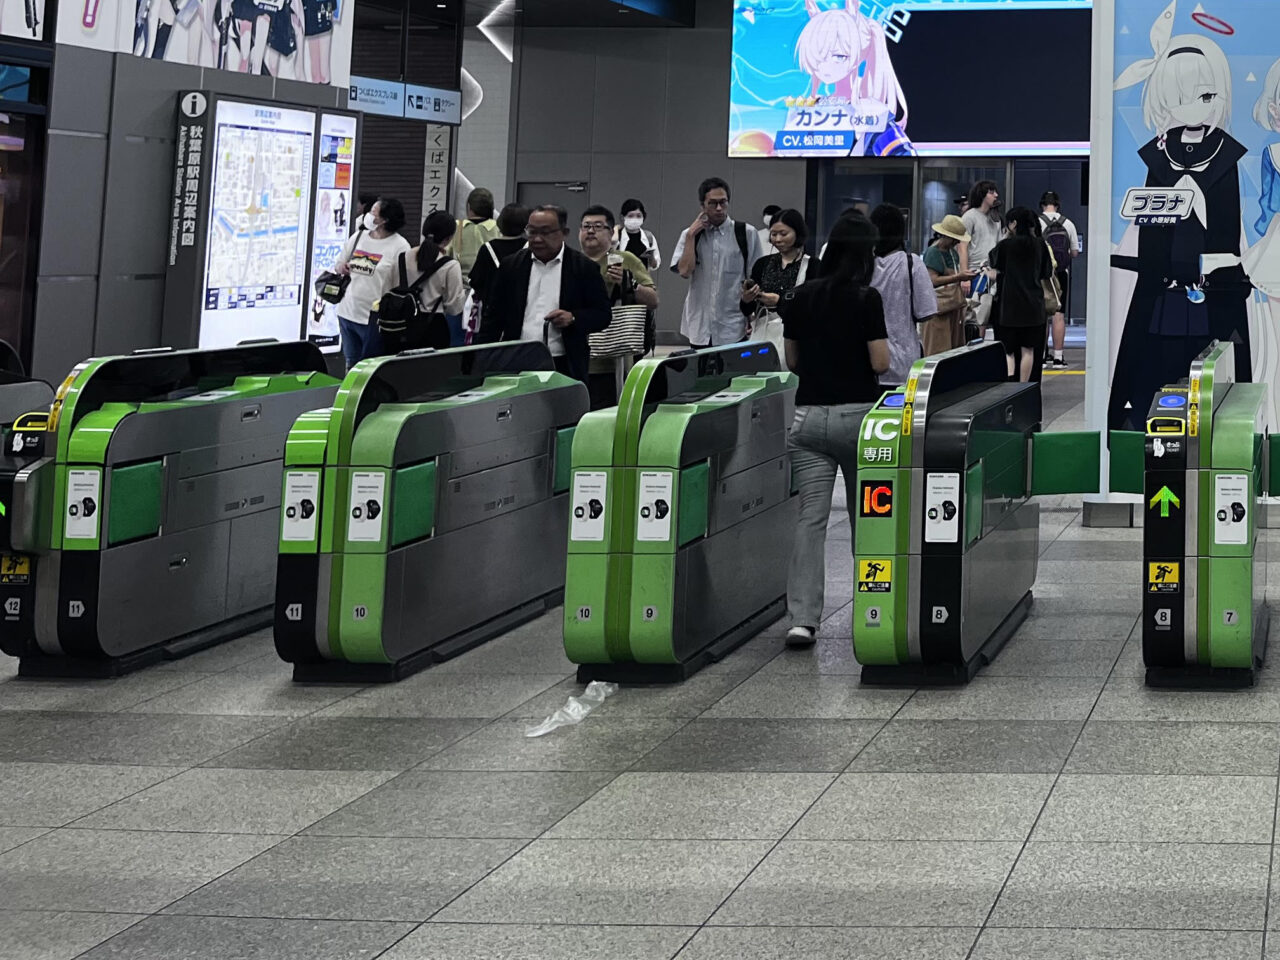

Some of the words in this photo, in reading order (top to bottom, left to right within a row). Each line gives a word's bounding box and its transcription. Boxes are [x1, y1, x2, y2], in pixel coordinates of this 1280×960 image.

[181, 125, 204, 246] 秋葉原駅周辺案内図
[1132, 194, 1186, 212] プラナ
[863, 418, 899, 441] IC
[863, 447, 892, 462] 専用
[864, 486, 892, 513] IC
[9, 601, 18, 610] 12
[71, 604, 81, 613] 11
[289, 607, 299, 617] 11
[354, 607, 366, 618] 10
[579, 608, 591, 619] 10
[646, 607, 653, 619] 9
[870, 608, 877, 620] 9
[935, 609, 943, 620] 8
[1160, 611, 1167, 621] 8
[1227, 612, 1234, 622] 7
